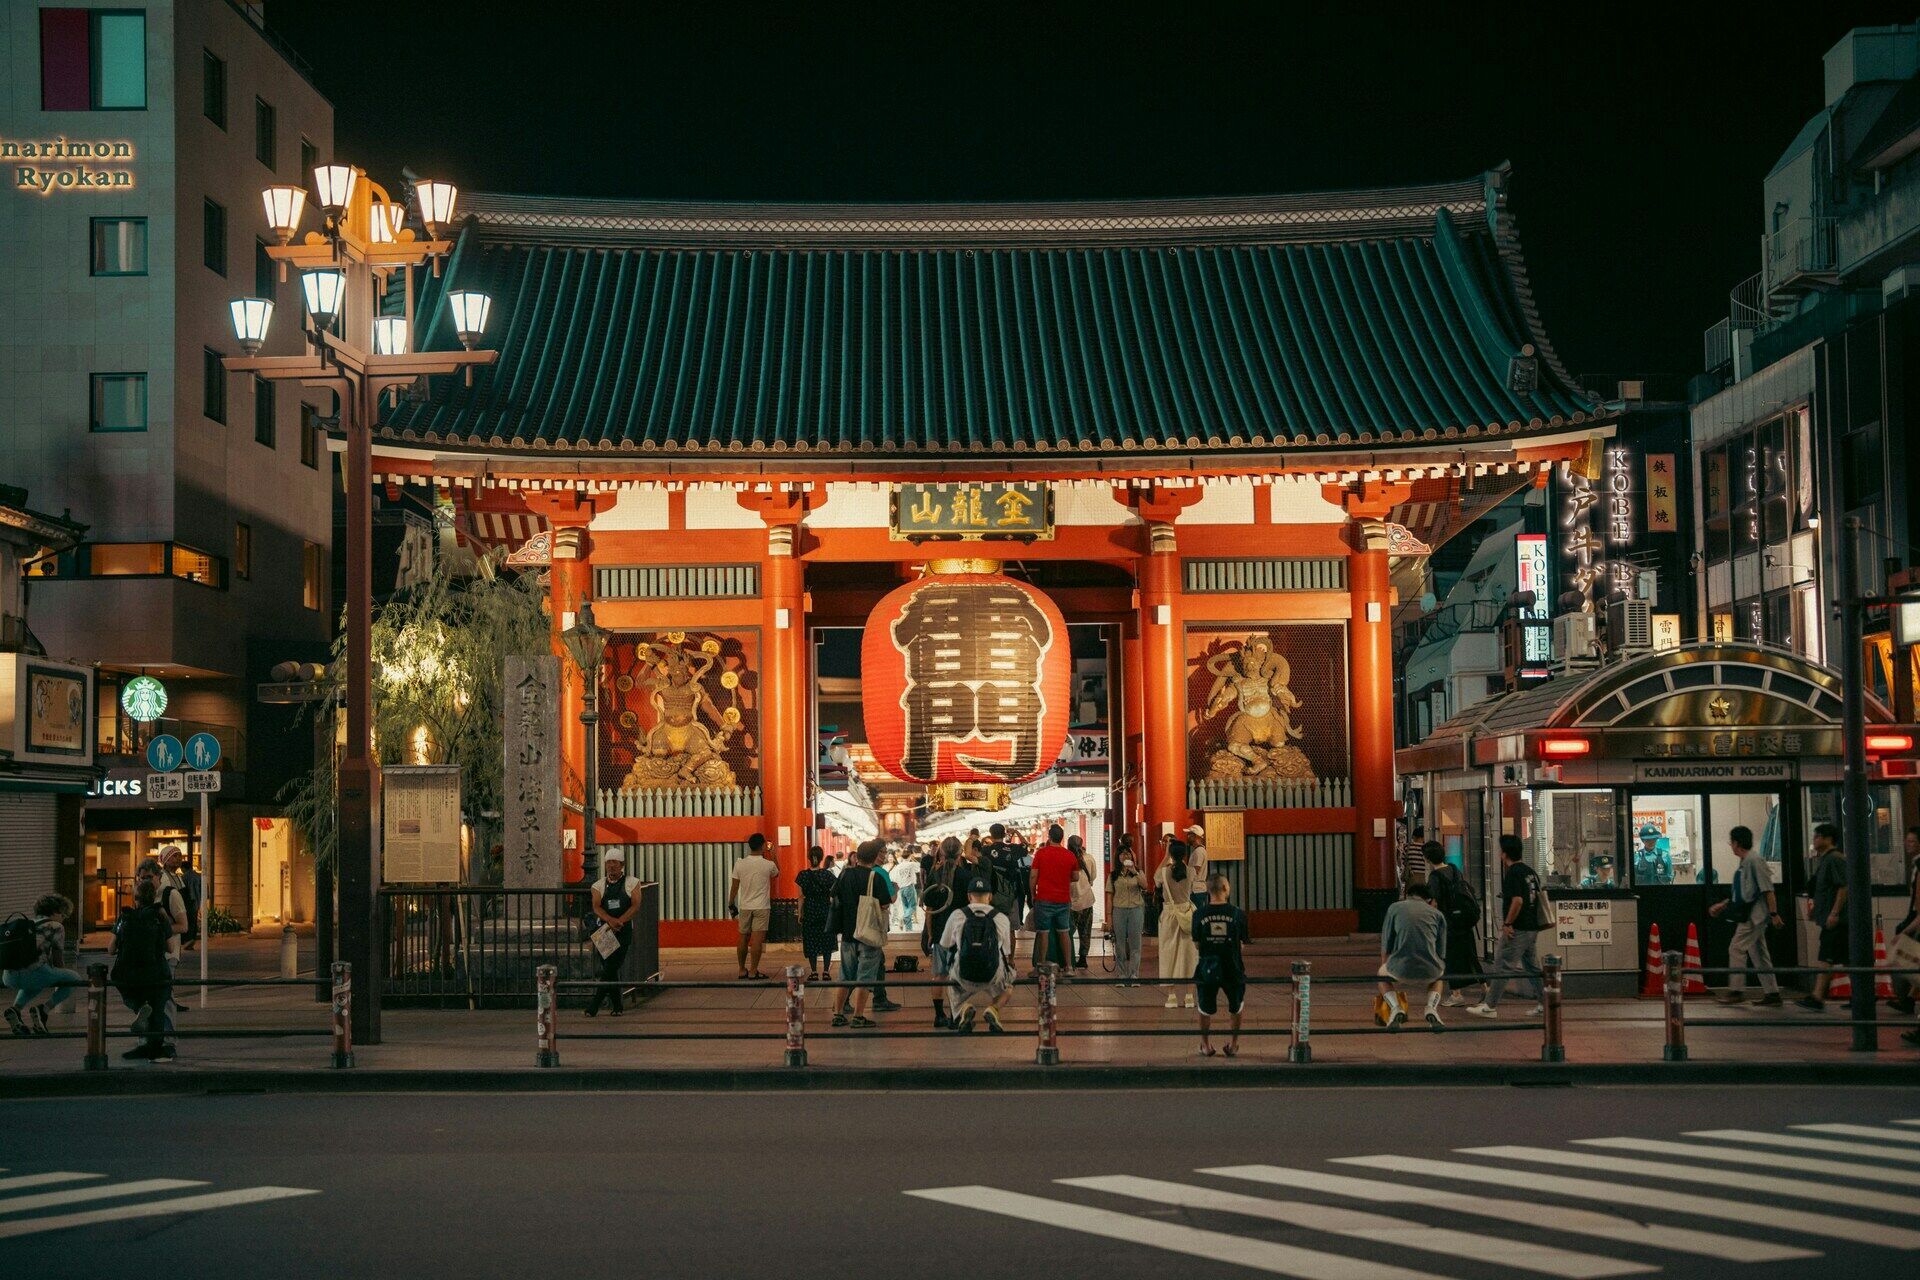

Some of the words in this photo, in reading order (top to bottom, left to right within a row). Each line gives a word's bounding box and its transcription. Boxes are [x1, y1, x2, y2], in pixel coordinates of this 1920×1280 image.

[2, 136, 131, 157] narimon
[17, 166, 131, 192] Ryokan
[1612, 450, 1630, 540] KOBE
[1653, 460, 1669, 523] 鉄板焼
[1534, 544, 1546, 602] KOBE
[1644, 766, 1734, 778] KAMINARIMON
[1740, 765, 1784, 777] KOBAN
